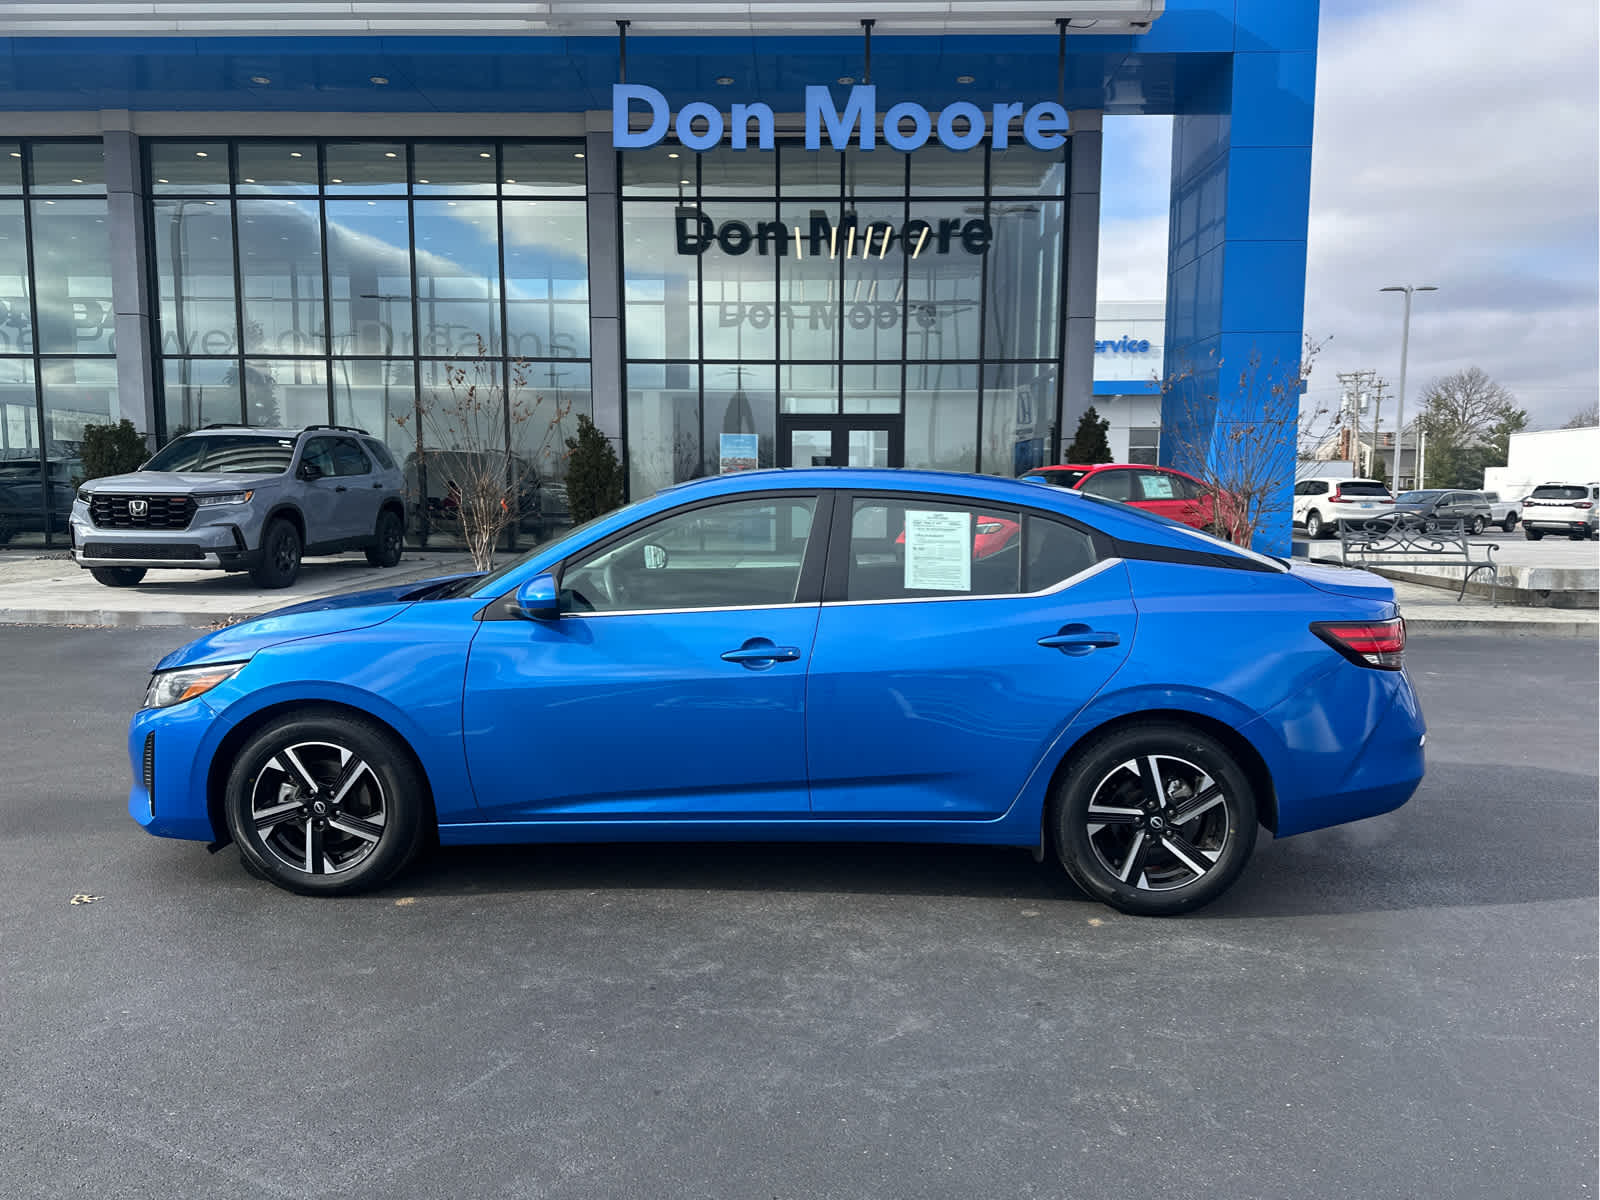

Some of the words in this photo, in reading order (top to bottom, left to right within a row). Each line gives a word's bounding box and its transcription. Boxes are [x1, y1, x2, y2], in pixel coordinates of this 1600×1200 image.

[613, 84, 775, 151] Don
[805, 85, 1069, 151] Moore
[675, 207, 789, 256] Don
[809, 209, 993, 256] Moore
[1095, 335, 1150, 353] ervice
